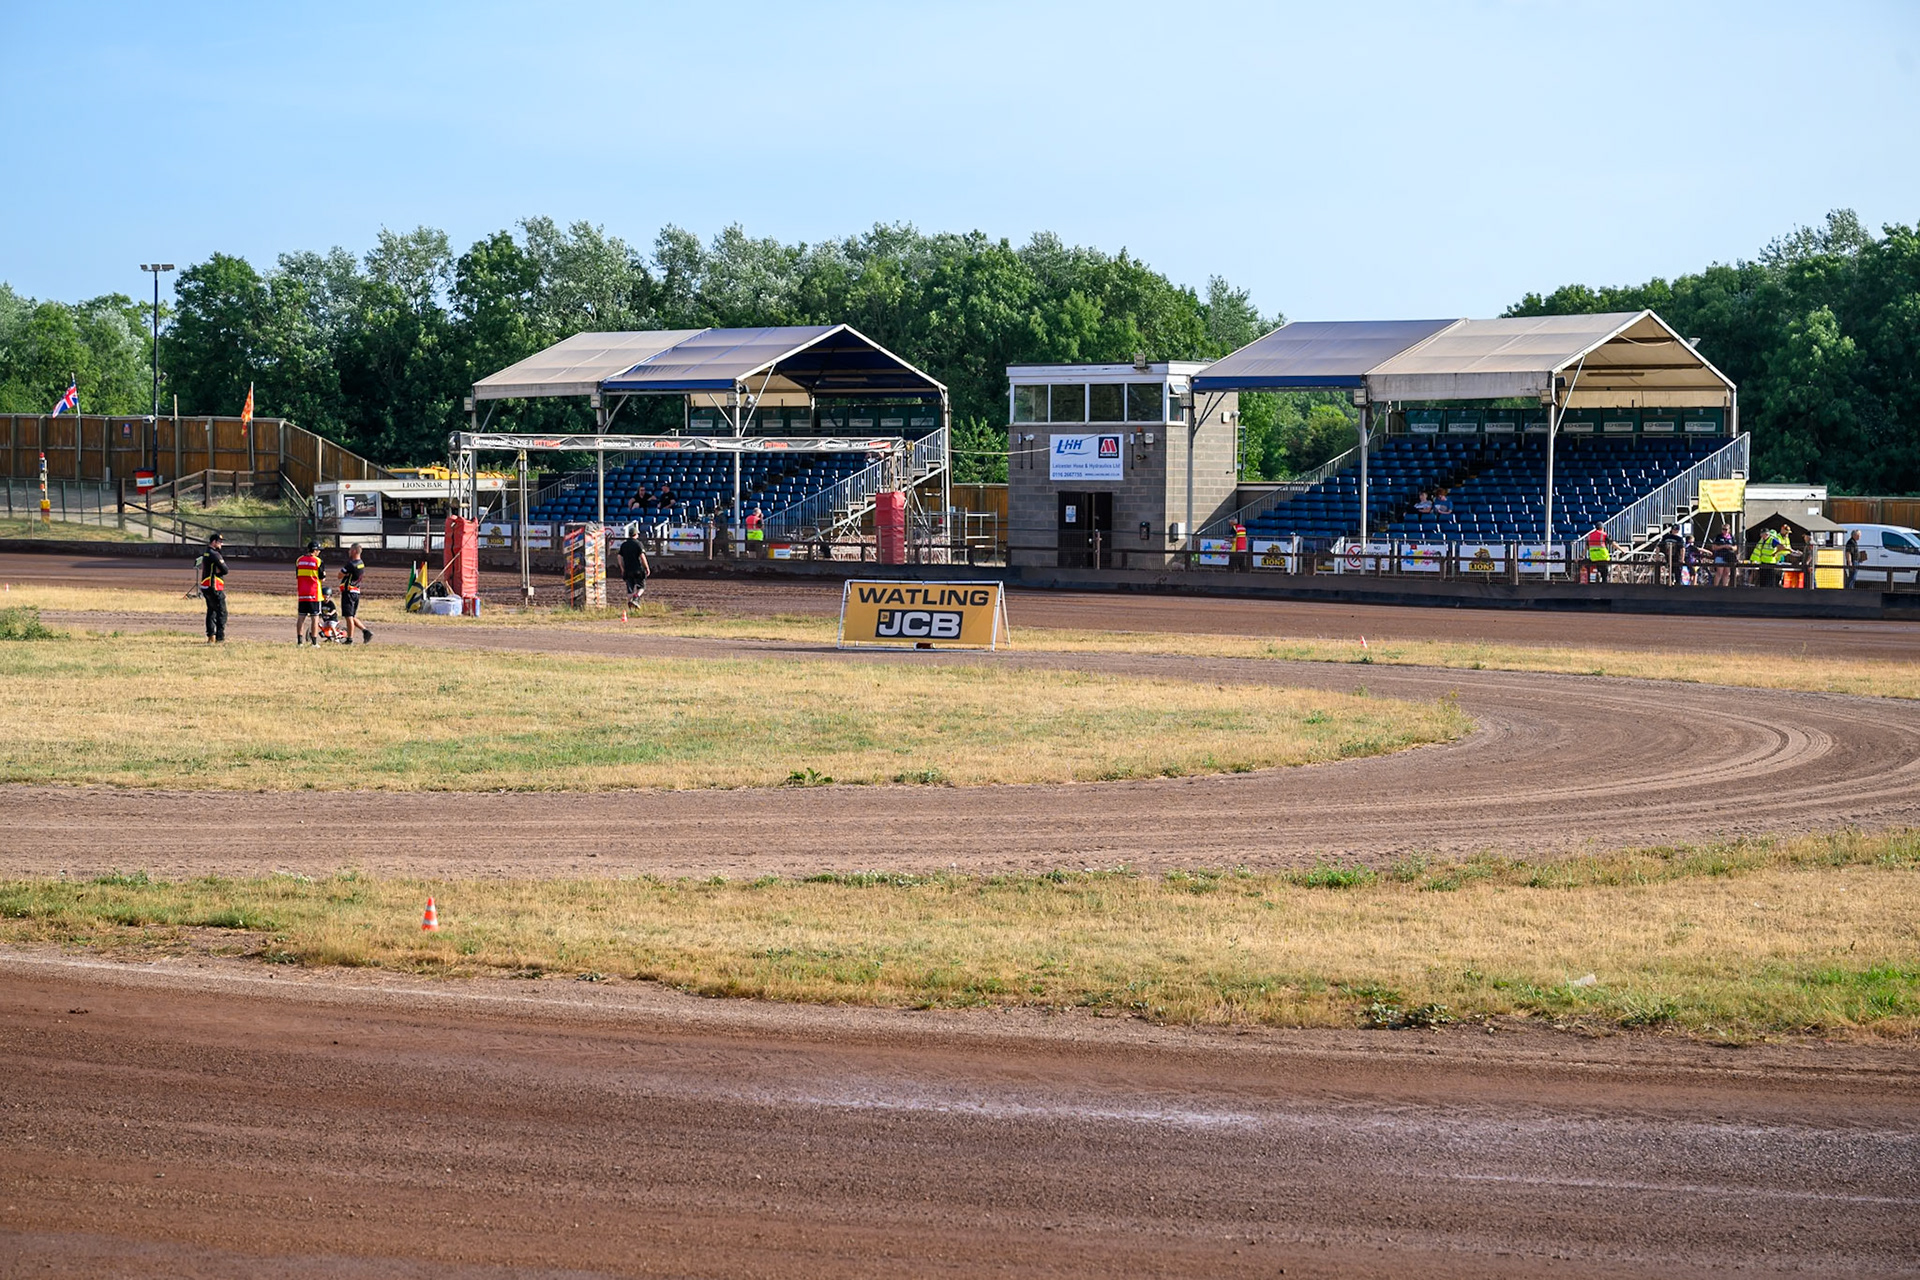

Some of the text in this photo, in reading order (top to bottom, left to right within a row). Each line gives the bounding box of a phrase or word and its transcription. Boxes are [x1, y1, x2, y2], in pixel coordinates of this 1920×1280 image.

[1056, 439, 1083, 454] LHH
[858, 587, 990, 606] WATLING
[878, 611, 960, 638] JCB
